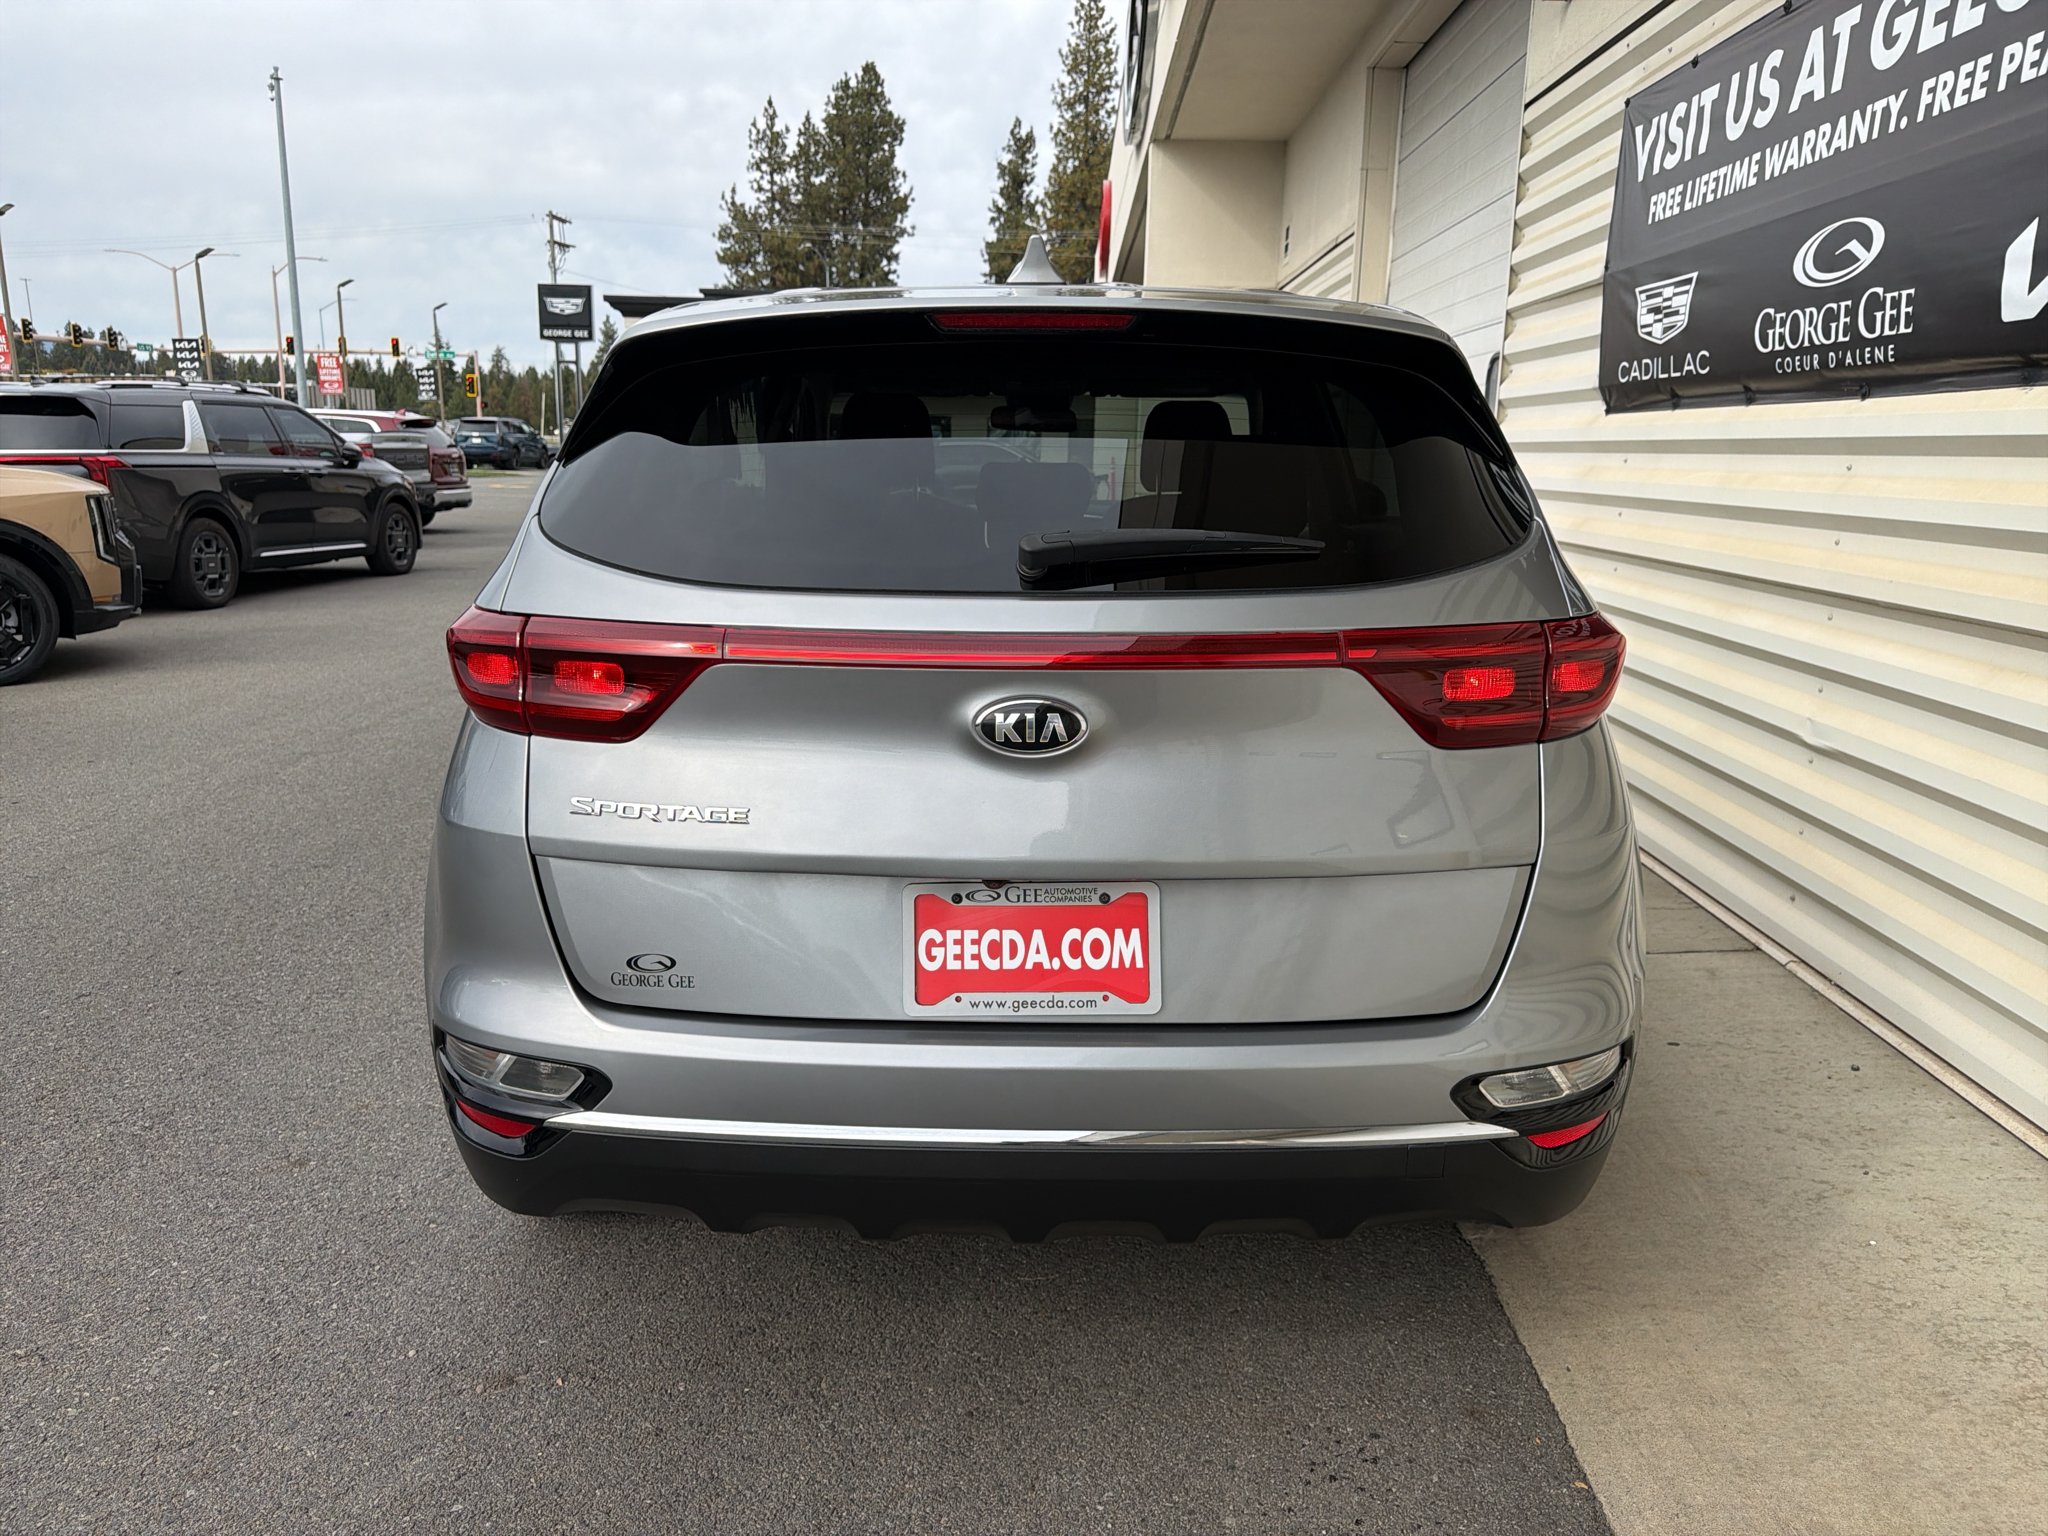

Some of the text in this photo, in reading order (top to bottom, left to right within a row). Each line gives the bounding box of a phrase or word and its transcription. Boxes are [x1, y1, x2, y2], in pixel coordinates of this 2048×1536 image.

[1634, 82, 1721, 183] VISIT
[1725, 48, 1784, 142] US
[1787, 3, 1863, 114] AT
[1647, 183, 1684, 225] FREE
[1683, 151, 1762, 212] LIFETIME
[1764, 88, 1909, 182] WARRANTY.
[1916, 52, 1994, 123] FREE
[1617, 350, 1711, 384] CADILLAC
[1775, 344, 1896, 374] COEUR D'ALENE
[994, 712, 1070, 744] KIA
[569, 796, 750, 824] SPORTAGE
[1004, 885, 1098, 903] GEE AUTOMOTIVE
[1043, 895, 1093, 903] COMPANIES
[918, 927, 1144, 972] GEECDA.COM
[610, 971, 696, 989] GEORGE GEE
[969, 995, 1098, 1013] www.geecda.com
